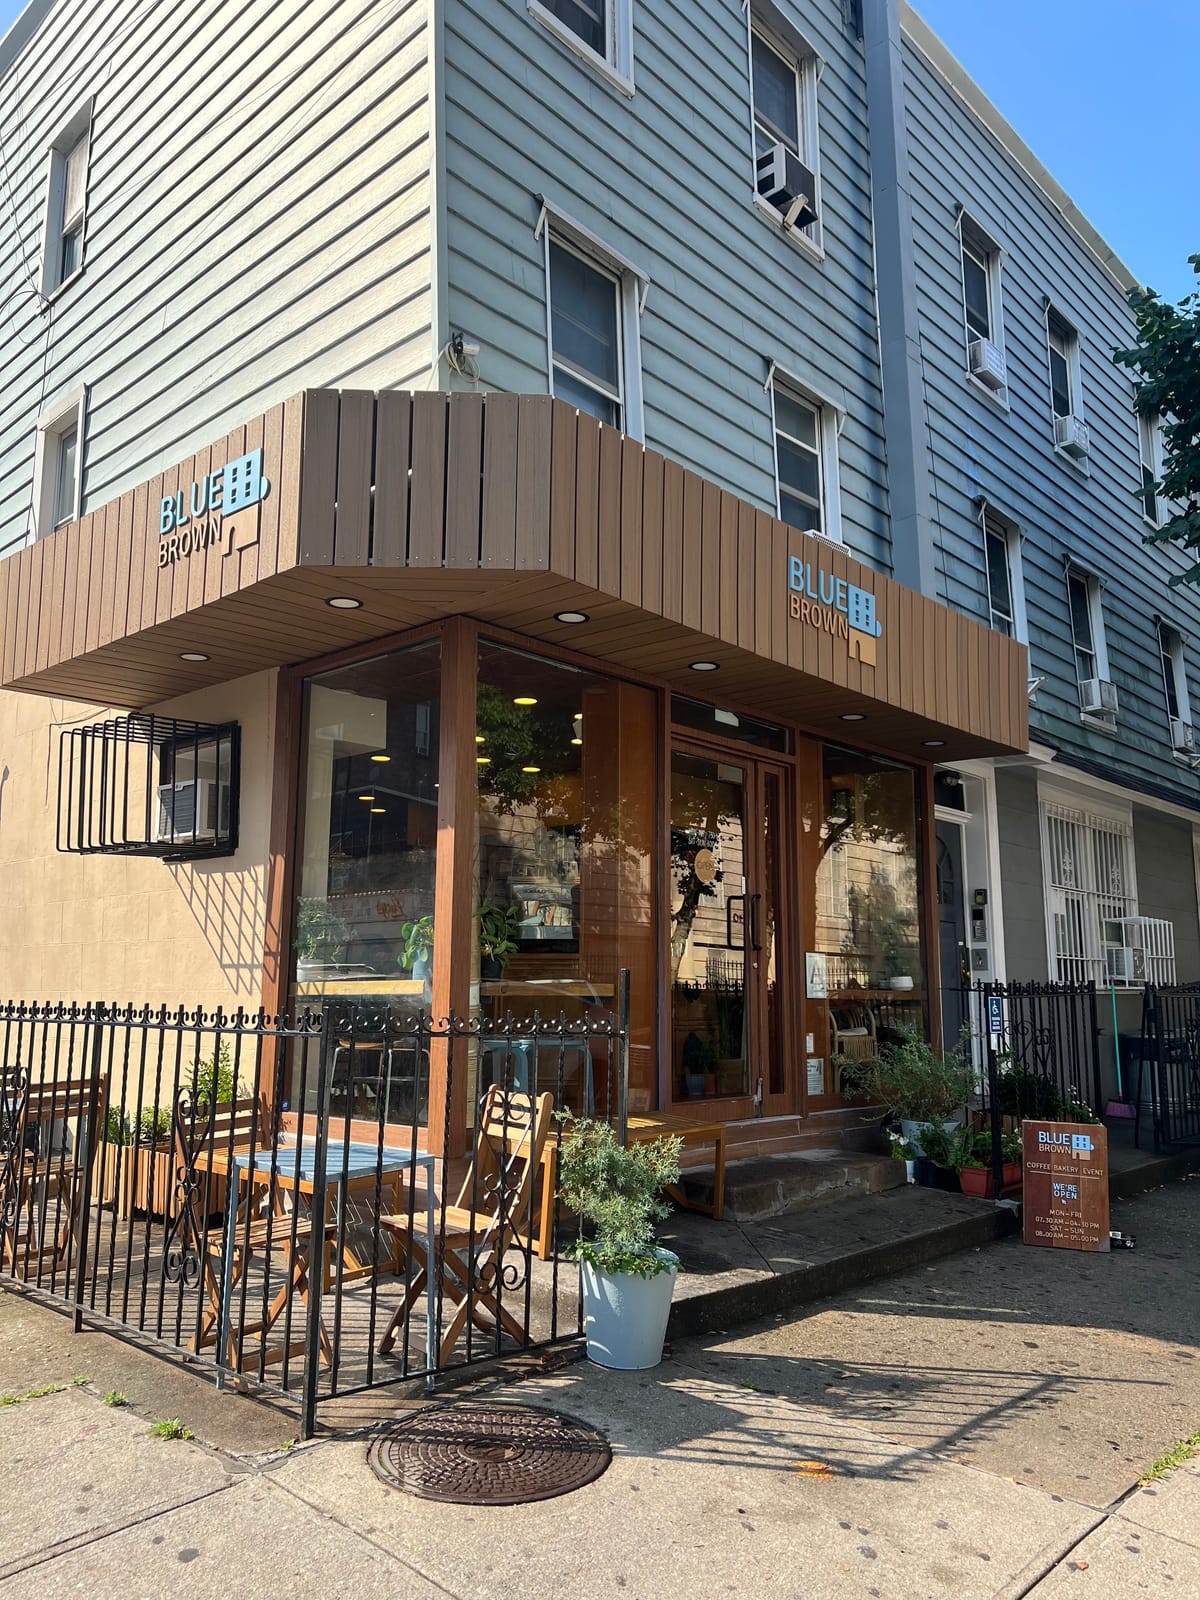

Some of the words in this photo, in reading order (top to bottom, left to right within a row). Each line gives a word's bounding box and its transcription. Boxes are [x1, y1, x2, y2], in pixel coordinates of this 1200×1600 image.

[160, 467, 224, 535] BLUE
[158, 515, 222, 568] BROWN
[789, 555, 848, 613] BLUE
[790, 593, 848, 640] BROWN
[1038, 1131, 1070, 1144] BLUE
[1038, 1144, 1071, 1154] BROWN
[1026, 1162, 1050, 1170] COFFEE
[1054, 1164, 1078, 1173] BAKERY
[1082, 1168, 1103, 1176] EVENT
[1053, 1183, 1078, 1192] WE'RE
[1054, 1191, 1077, 1199] OPEN
[1049, 1224, 1062, 1232] SAT
[1070, 1227, 1085, 1235] SUN
[1089, 1222, 1100, 1230] PM
